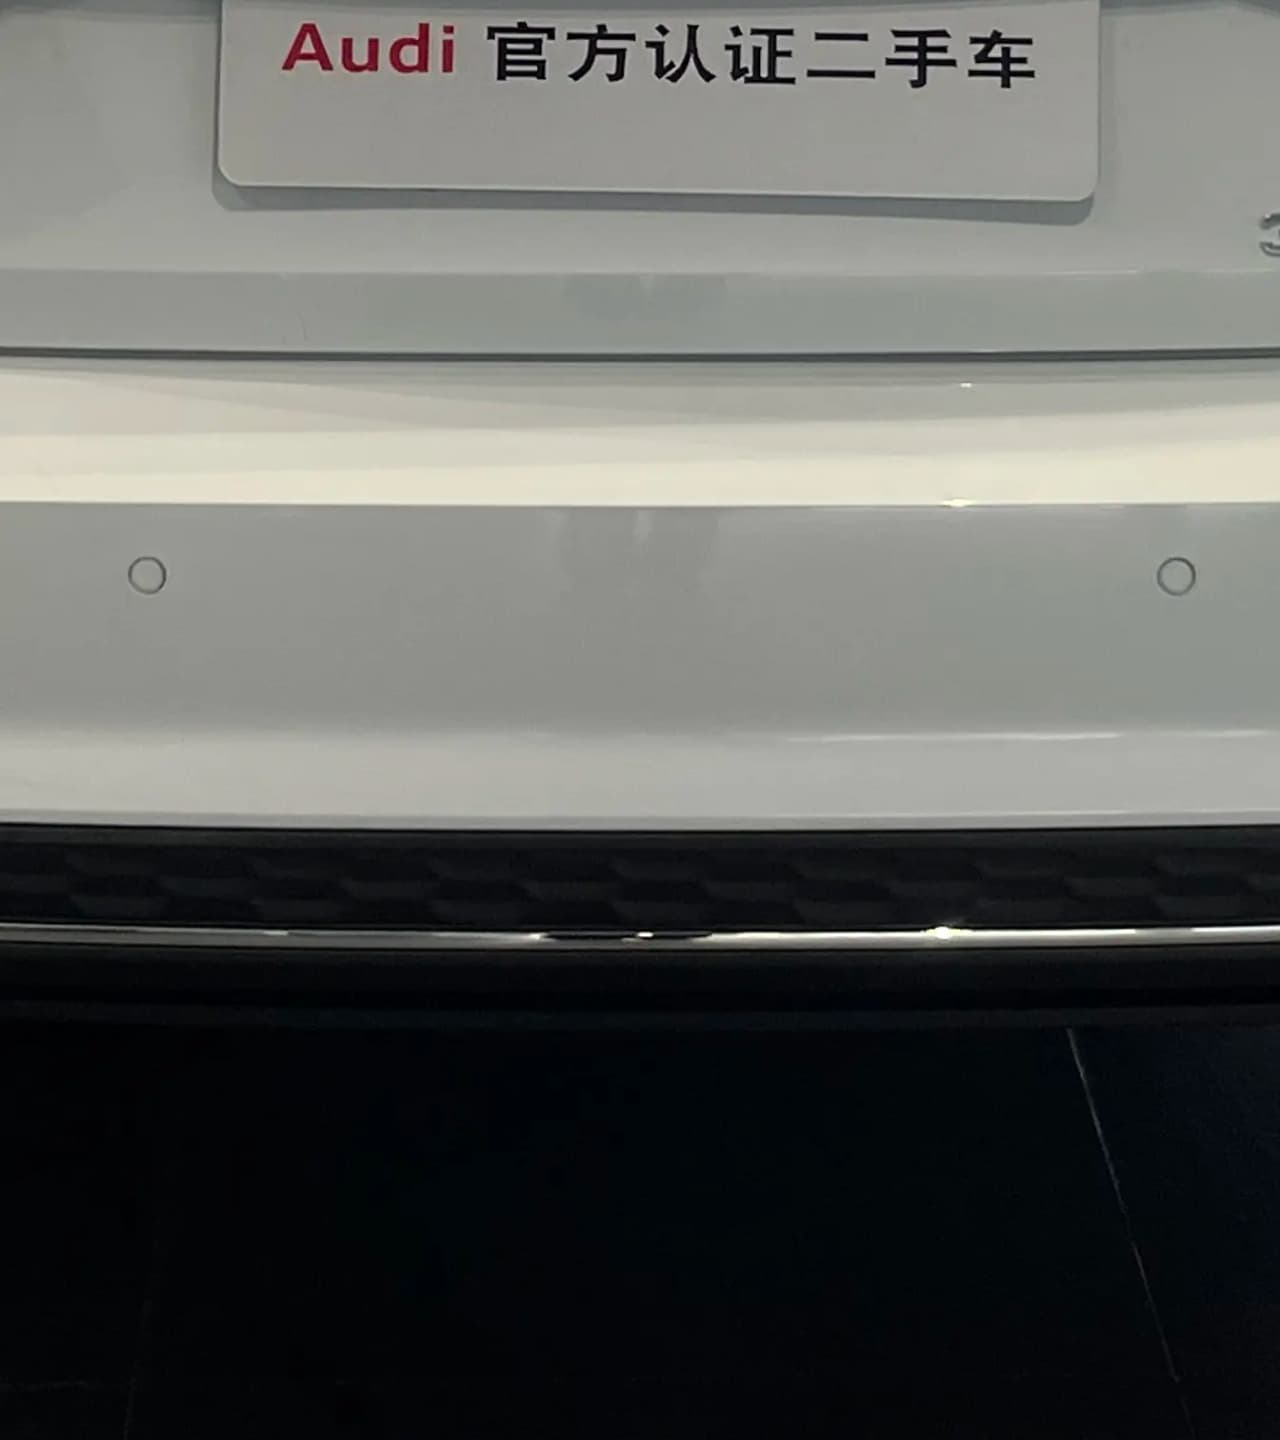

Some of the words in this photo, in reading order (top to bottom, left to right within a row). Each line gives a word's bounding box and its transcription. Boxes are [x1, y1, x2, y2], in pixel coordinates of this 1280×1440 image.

[282, 22, 457, 74] Audi
[487, 21, 1037, 89] 官方认证二手车
